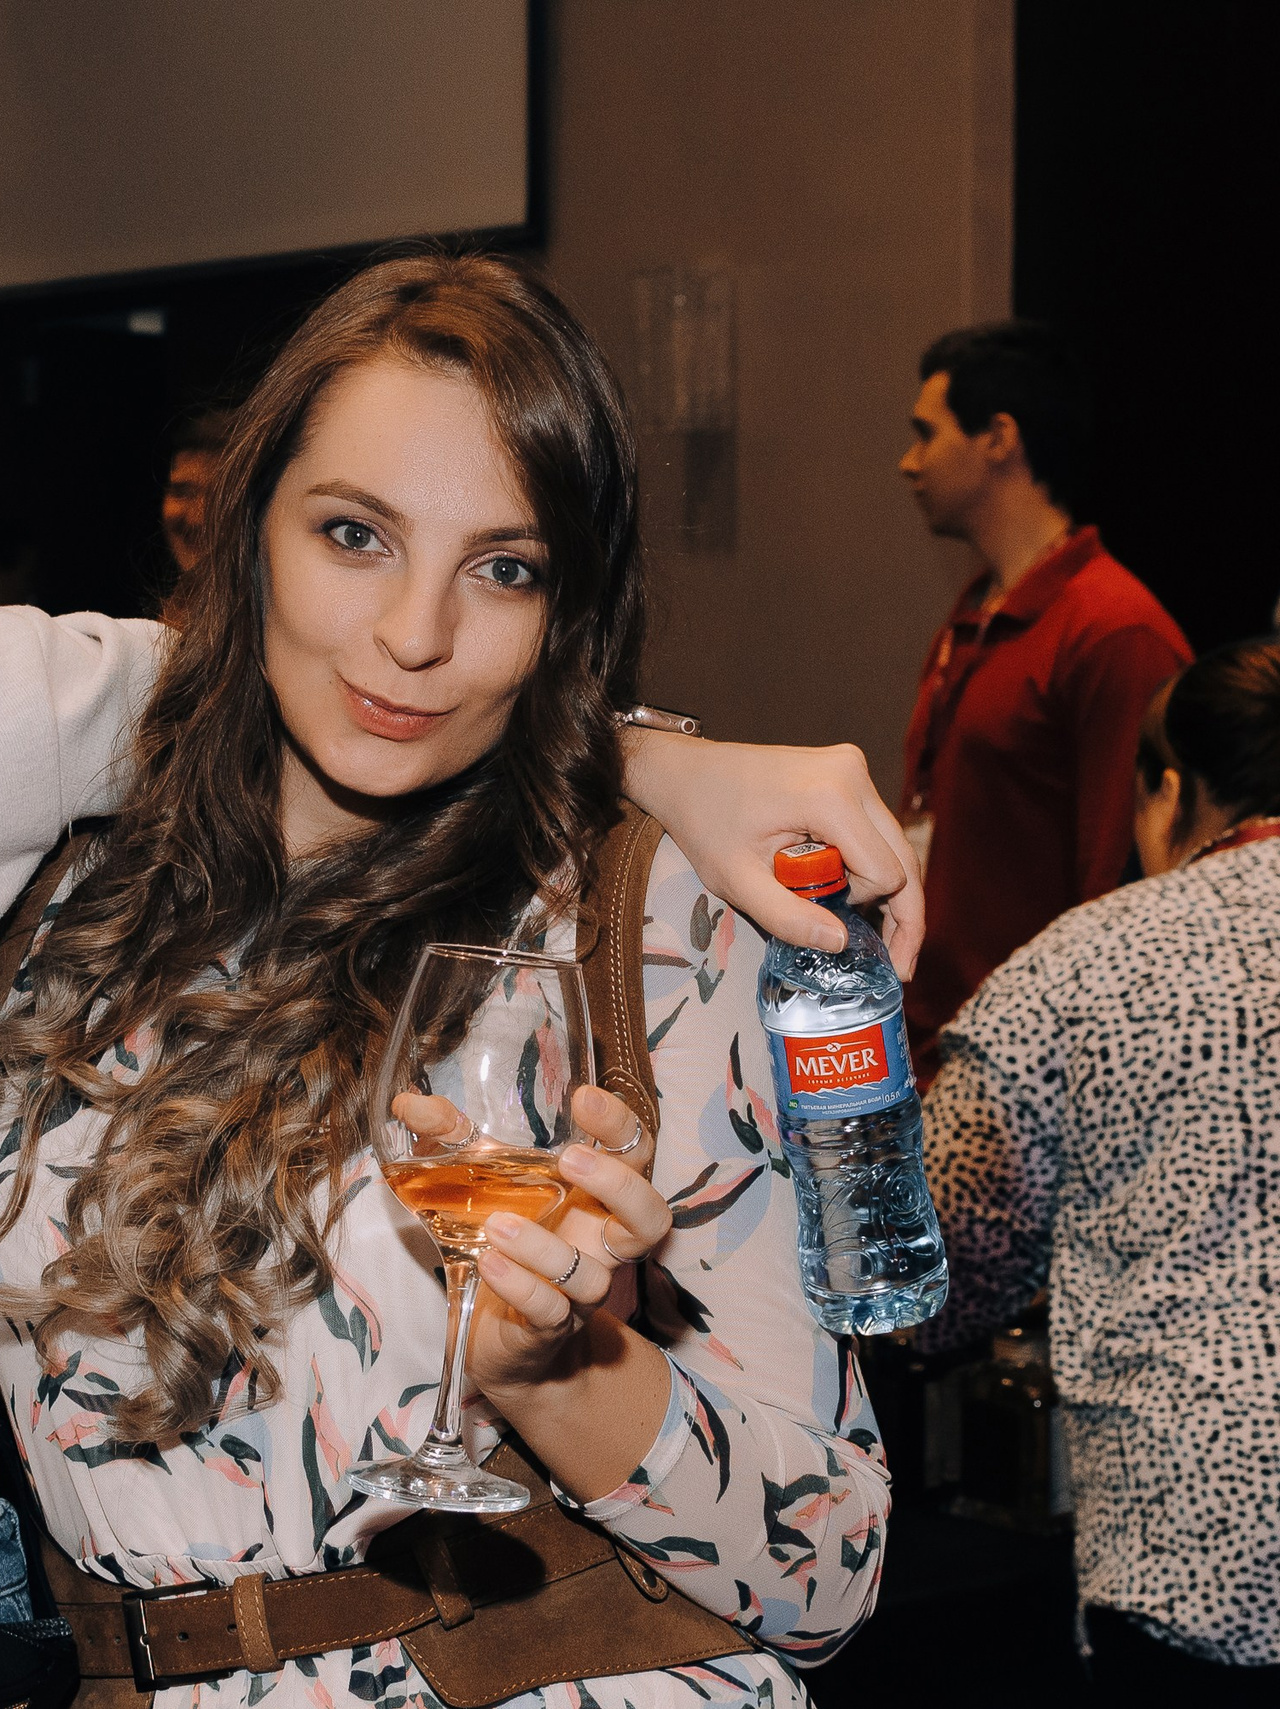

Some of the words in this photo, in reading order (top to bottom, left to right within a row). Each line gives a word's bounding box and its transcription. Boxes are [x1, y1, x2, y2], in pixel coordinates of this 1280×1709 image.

[795, 1048, 879, 1076] MEVER
[801, 1103, 827, 1111] ПИТЬЕВАЯ
[827, 1099, 867, 1110] МИНЕРАЛЬНАЯ
[867, 1095, 882, 1104] ВОДА
